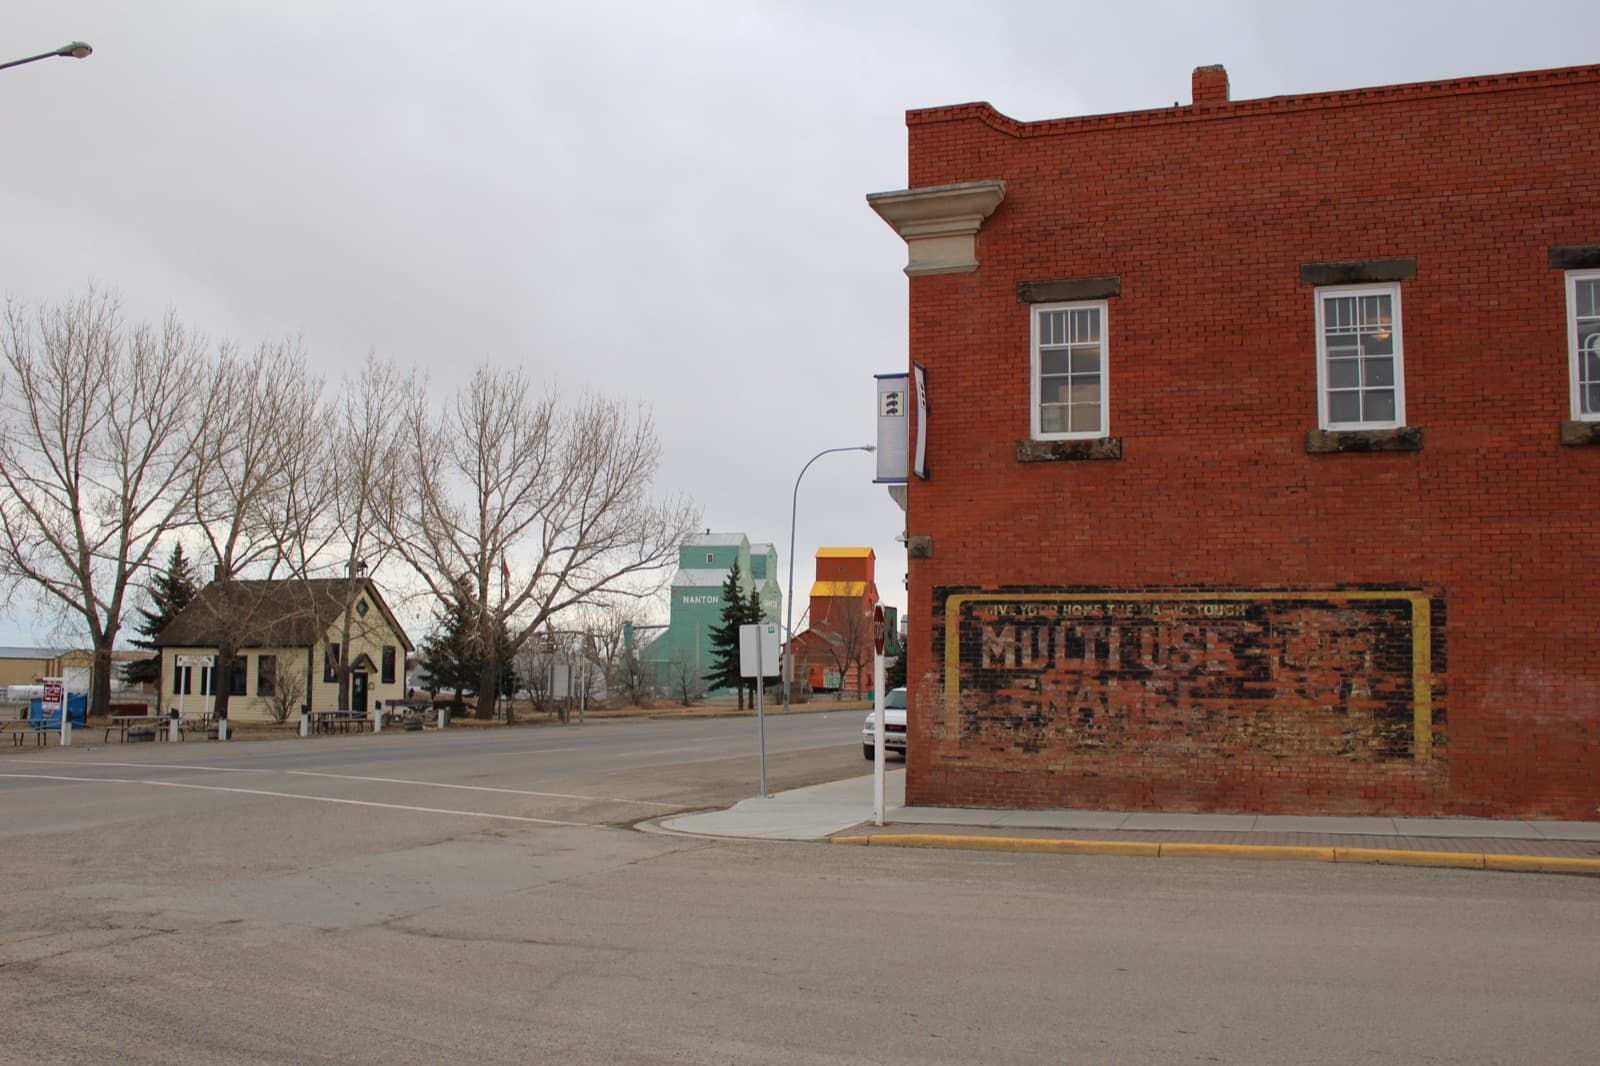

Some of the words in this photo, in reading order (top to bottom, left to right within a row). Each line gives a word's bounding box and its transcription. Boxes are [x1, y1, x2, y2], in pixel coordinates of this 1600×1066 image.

[683, 595, 719, 604] NANTON
[1021, 604, 1058, 616] YOR
[982, 625, 1121, 671] MULTI
